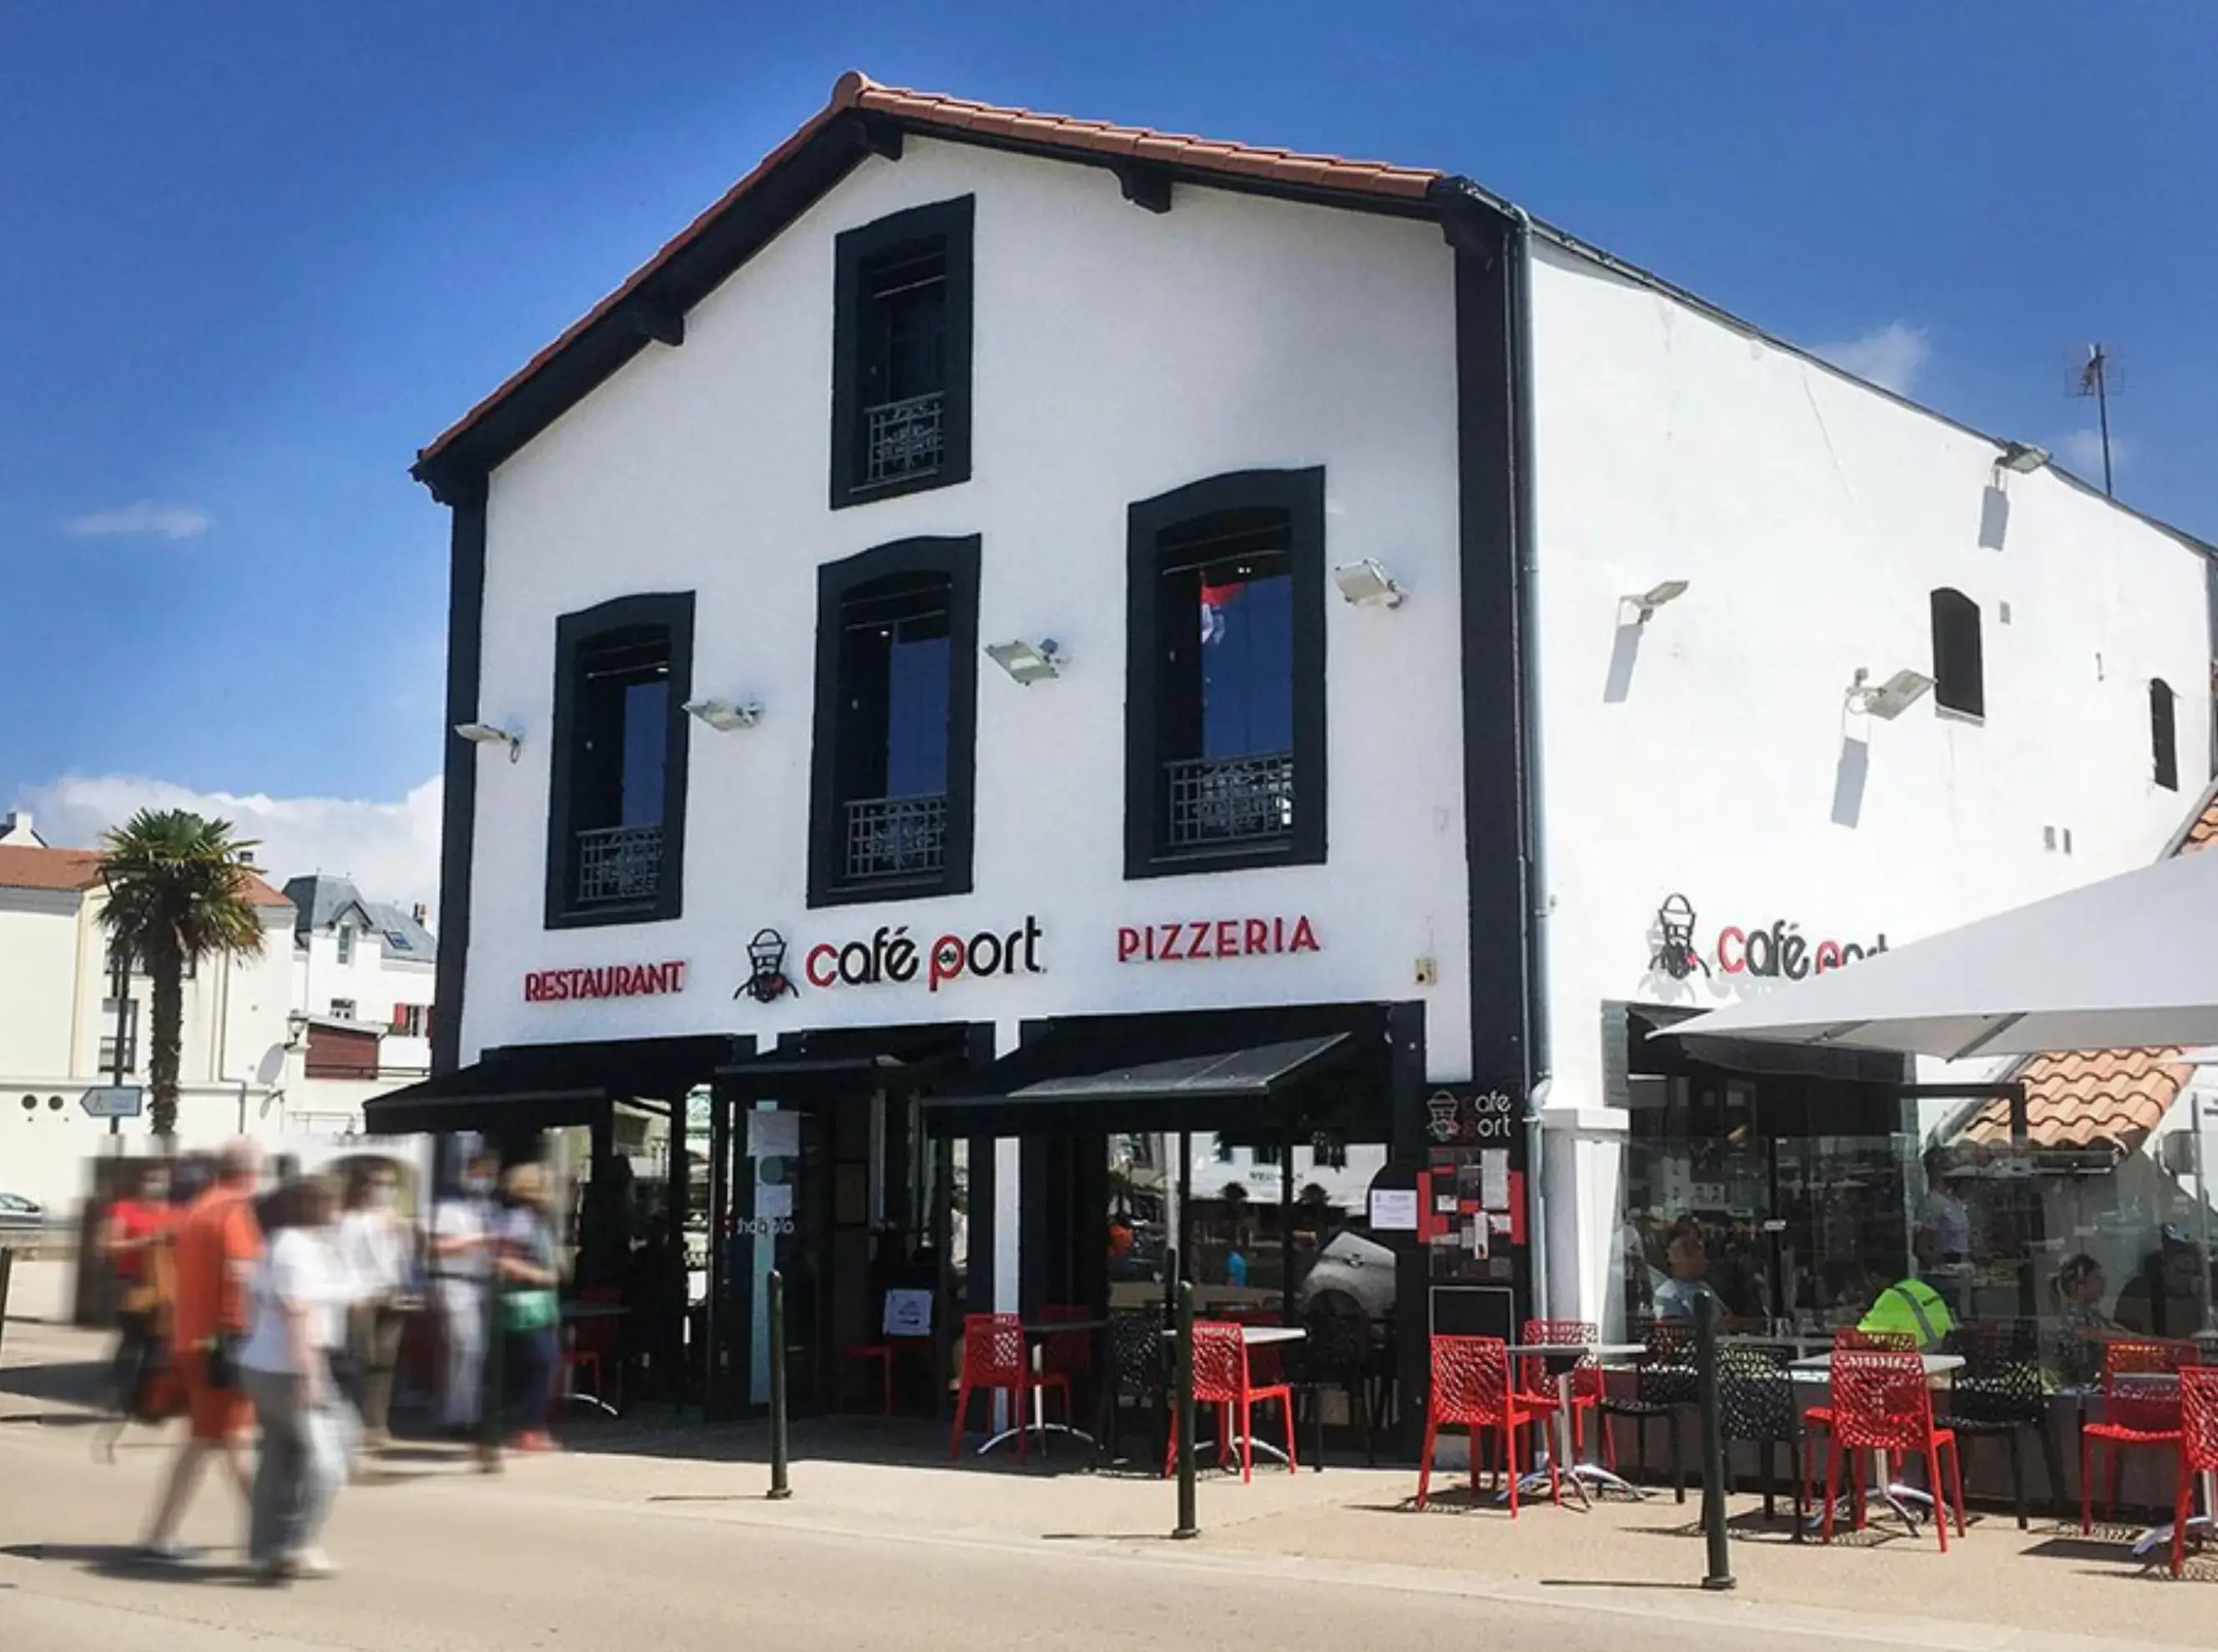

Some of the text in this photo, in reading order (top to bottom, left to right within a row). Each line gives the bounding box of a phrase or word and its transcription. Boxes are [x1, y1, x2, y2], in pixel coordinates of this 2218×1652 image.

[805, 925, 920, 986] café
[1118, 914, 1320, 961] PIZZERIA
[1717, 919, 1809, 980] café
